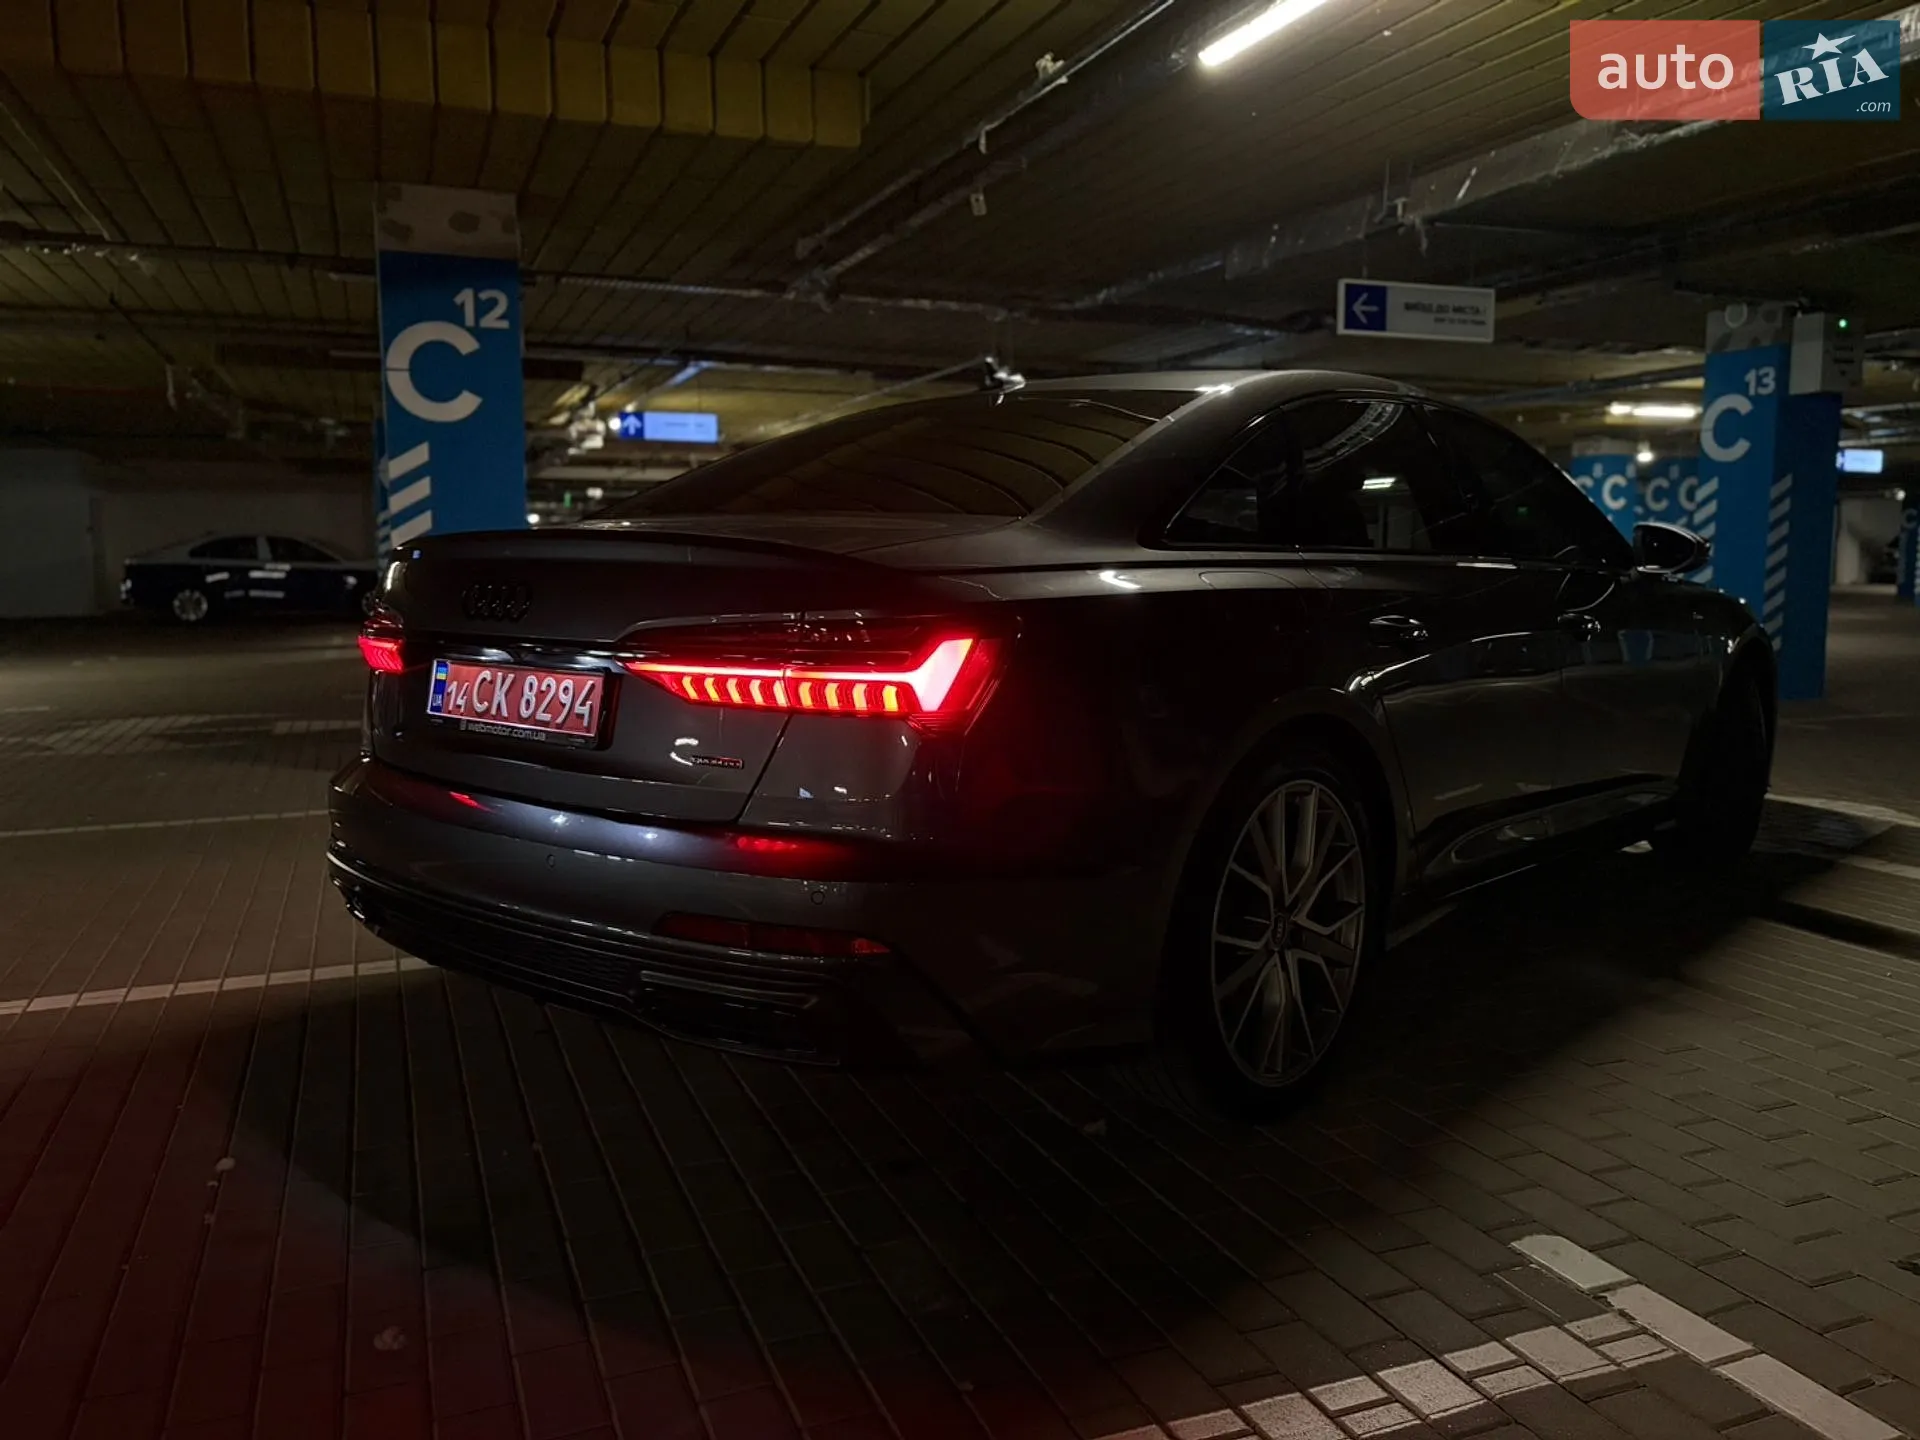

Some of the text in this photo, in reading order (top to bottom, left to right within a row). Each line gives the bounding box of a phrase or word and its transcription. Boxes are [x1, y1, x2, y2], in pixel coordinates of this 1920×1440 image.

[386, 288, 509, 423] C 12
[1701, 366, 1777, 462] C 13
[1601, 474, 1628, 510] C
[1645, 476, 1670, 512] C
[520, 675, 595, 727] 8294
